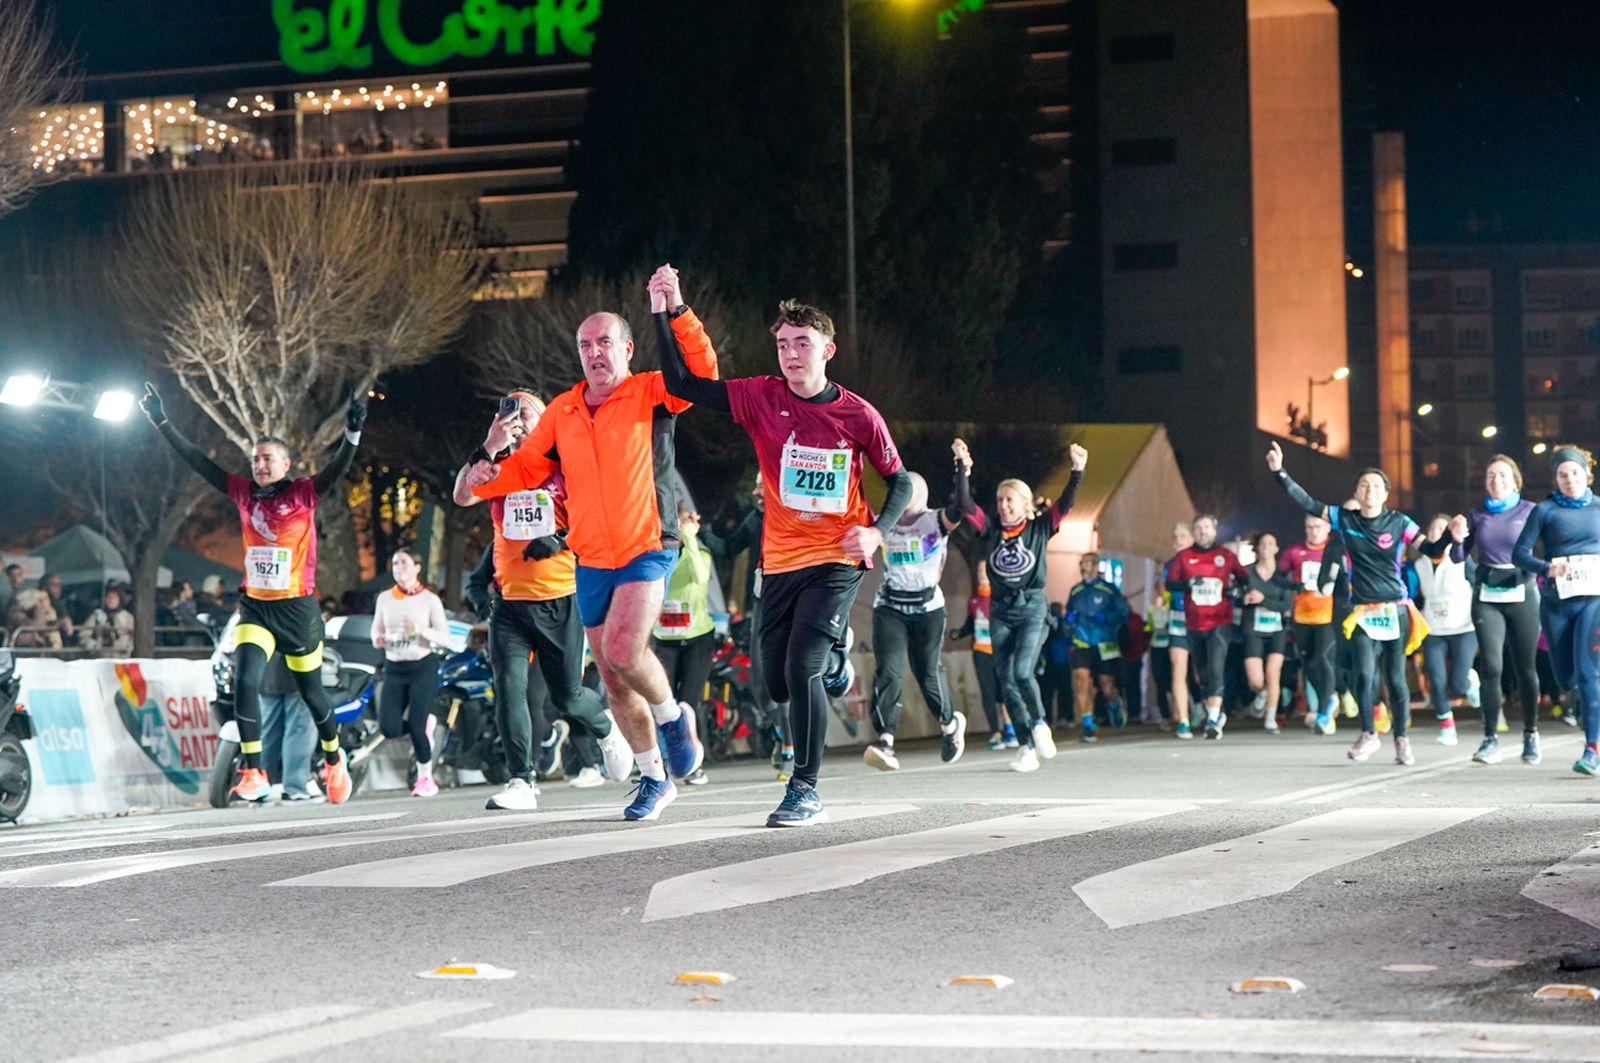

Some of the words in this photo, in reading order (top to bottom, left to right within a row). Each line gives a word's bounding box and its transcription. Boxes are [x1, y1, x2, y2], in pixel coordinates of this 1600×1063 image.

[376, 0, 600, 65] Corte
[795, 469, 835, 491] 2128
[514, 507, 543, 522] 1454
[255, 562, 279, 575] 1621
[167, 696, 209, 731] SAN
[40, 724, 84, 752] alsa
[141, 713, 173, 767] 43
